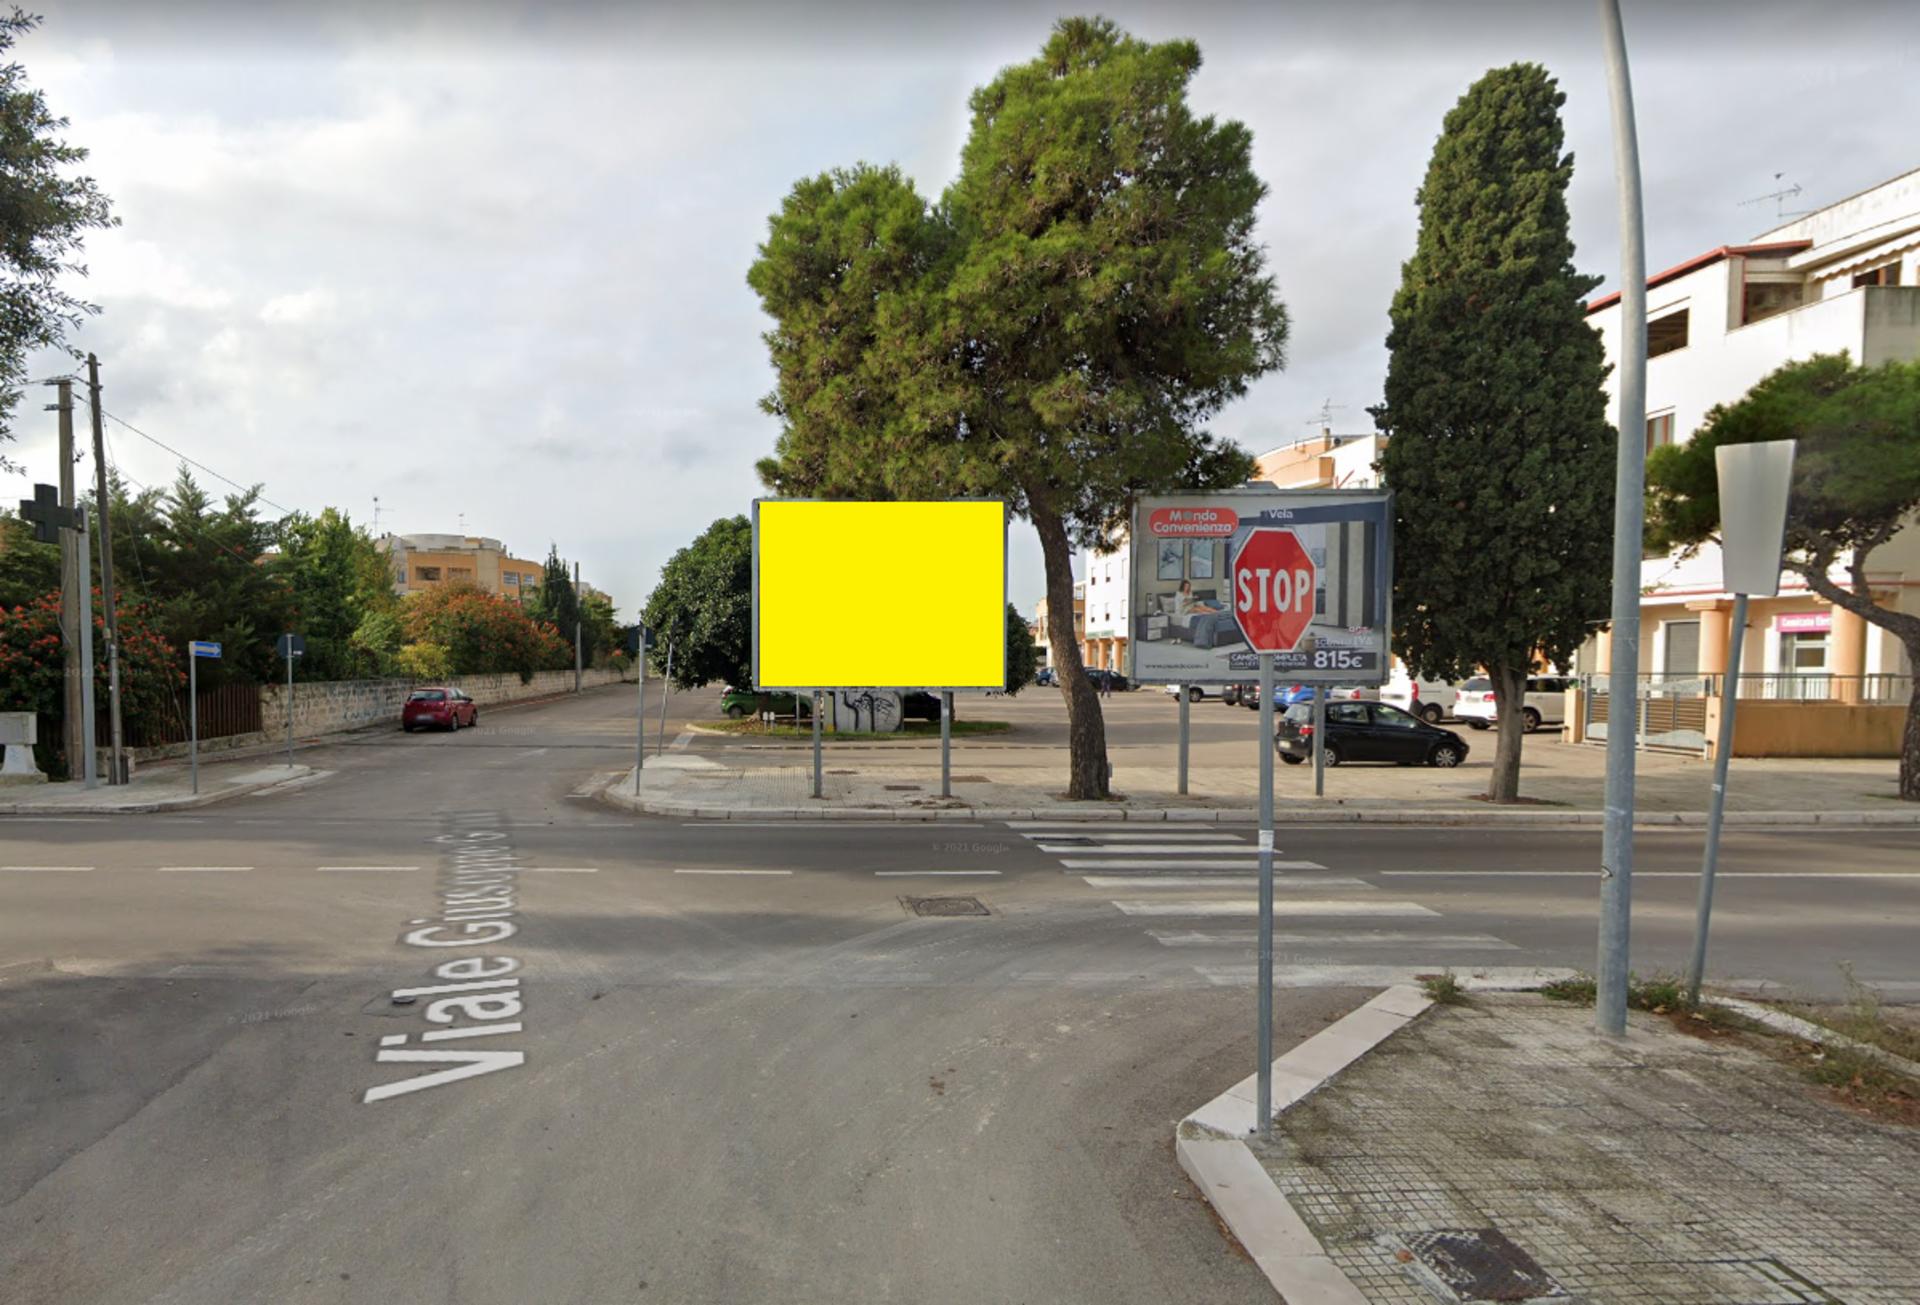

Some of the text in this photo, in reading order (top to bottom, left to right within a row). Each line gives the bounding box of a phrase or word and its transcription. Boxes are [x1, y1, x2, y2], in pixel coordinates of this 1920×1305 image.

[1169, 510, 1217, 521] Mondo
[1153, 521, 1233, 534] Convenienza
[1238, 568, 1311, 614] STOP
[1314, 650, 1364, 669] 815€
